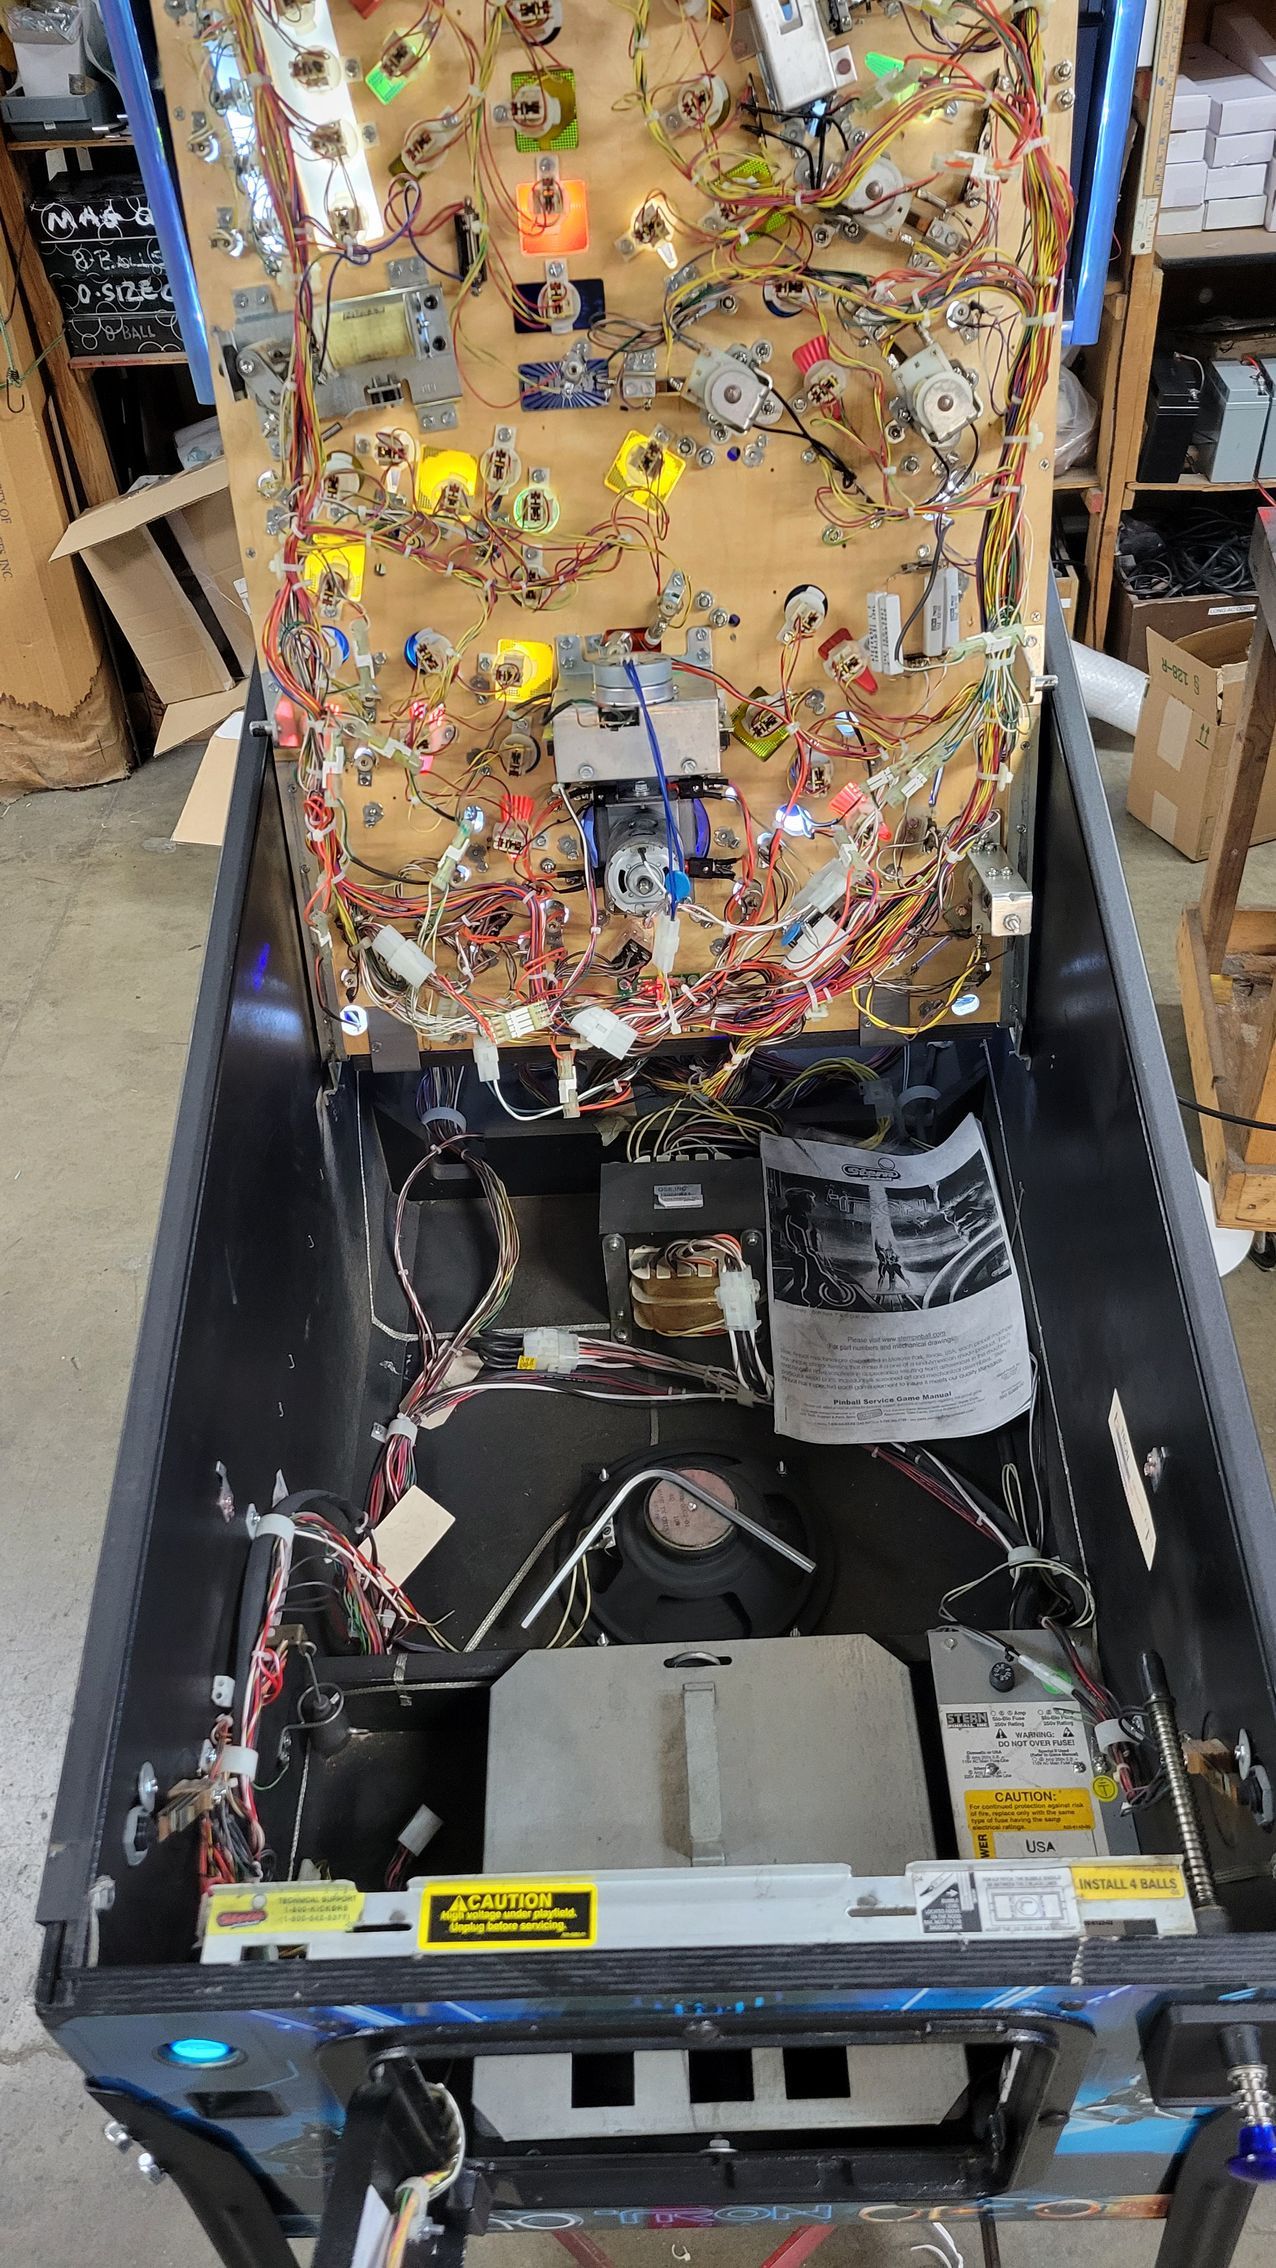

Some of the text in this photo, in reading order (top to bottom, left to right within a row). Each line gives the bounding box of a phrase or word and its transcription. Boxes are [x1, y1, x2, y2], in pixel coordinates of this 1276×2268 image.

[122, 324, 156, 340] BALL
[0, 508, 12, 525] OF
[0, 559, 13, 582] INC.
[863, 1397, 894, 1405] Service
[922, 1391, 952, 1400] Manual
[947, 1713, 988, 1724] STERN
[995, 1791, 1056, 1802] CAUTION:
[1026, 1840, 1056, 1853] USA
[1079, 1878, 1178, 1889] INSTALL 4 BALLS
[321, 1894, 356, 1903] SUPPORT
[467, 1893, 552, 1910] CAUTION
[440, 1907, 577, 1921] High voltage under playfield.
[448, 1920, 567, 1934] Unplug before servicing.
[594, 2204, 832, 2224] TRON
